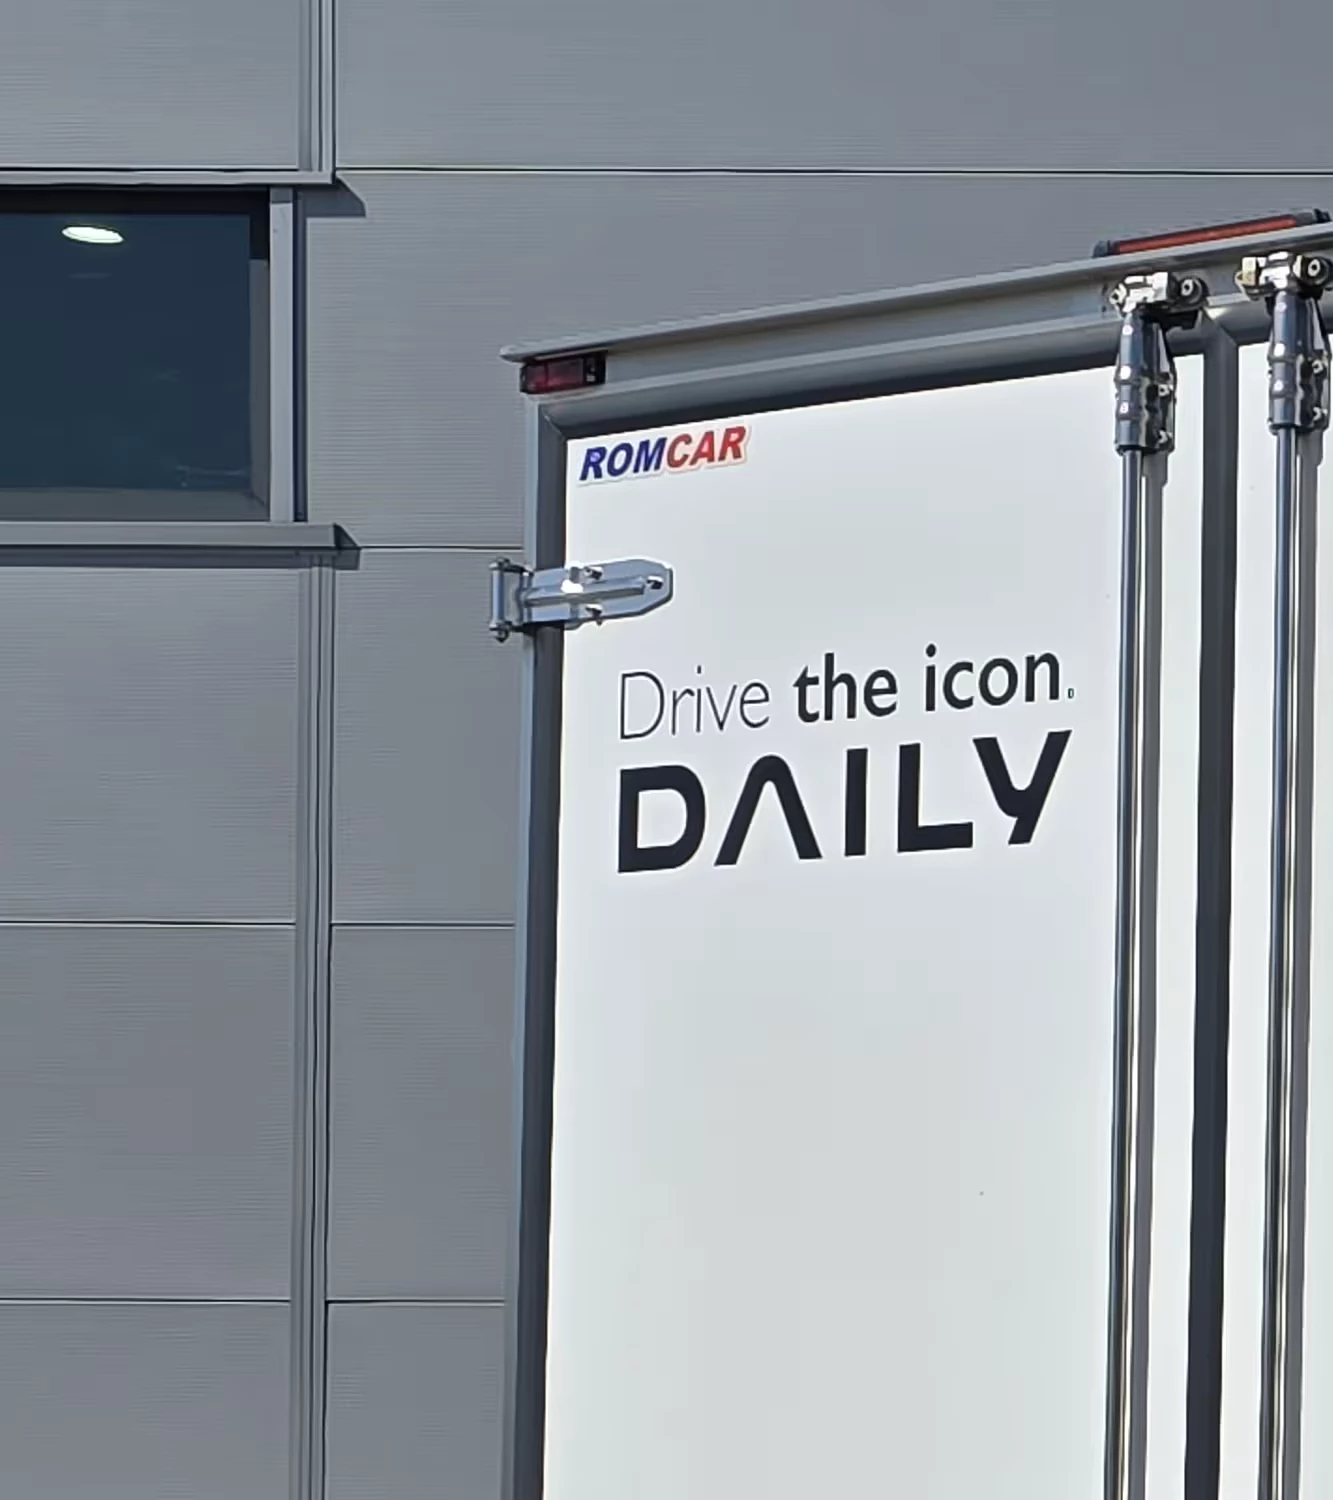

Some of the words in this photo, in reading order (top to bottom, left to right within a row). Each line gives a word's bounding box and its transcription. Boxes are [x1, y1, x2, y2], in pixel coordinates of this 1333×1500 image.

[579, 425, 747, 481] ROMCAR
[620, 664, 770, 740] Drive
[793, 652, 898, 723] the
[618, 729, 1072, 873] DAILY
